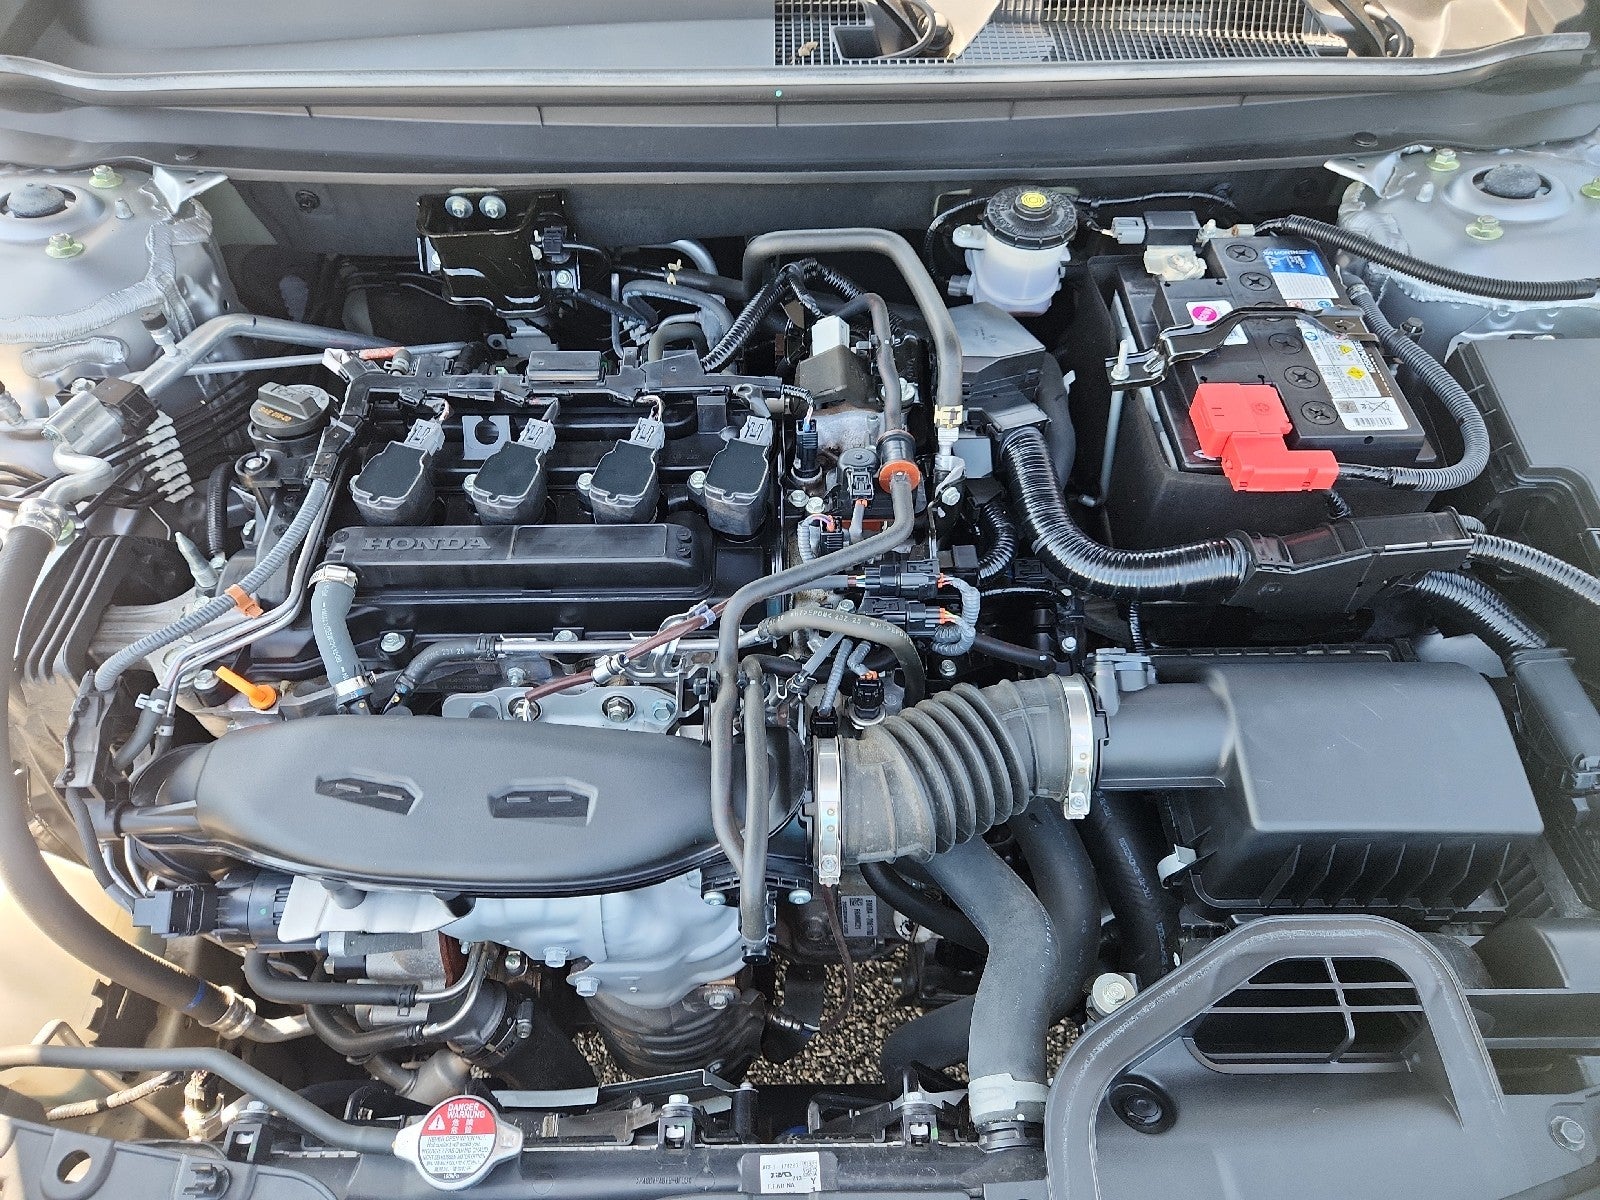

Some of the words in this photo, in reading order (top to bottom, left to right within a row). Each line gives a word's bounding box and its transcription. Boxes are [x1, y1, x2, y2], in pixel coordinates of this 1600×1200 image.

[362, 536, 492, 551] HONDA
[447, 1103, 480, 1111] DANGER
[447, 1110, 486, 1119] WARNUNG
